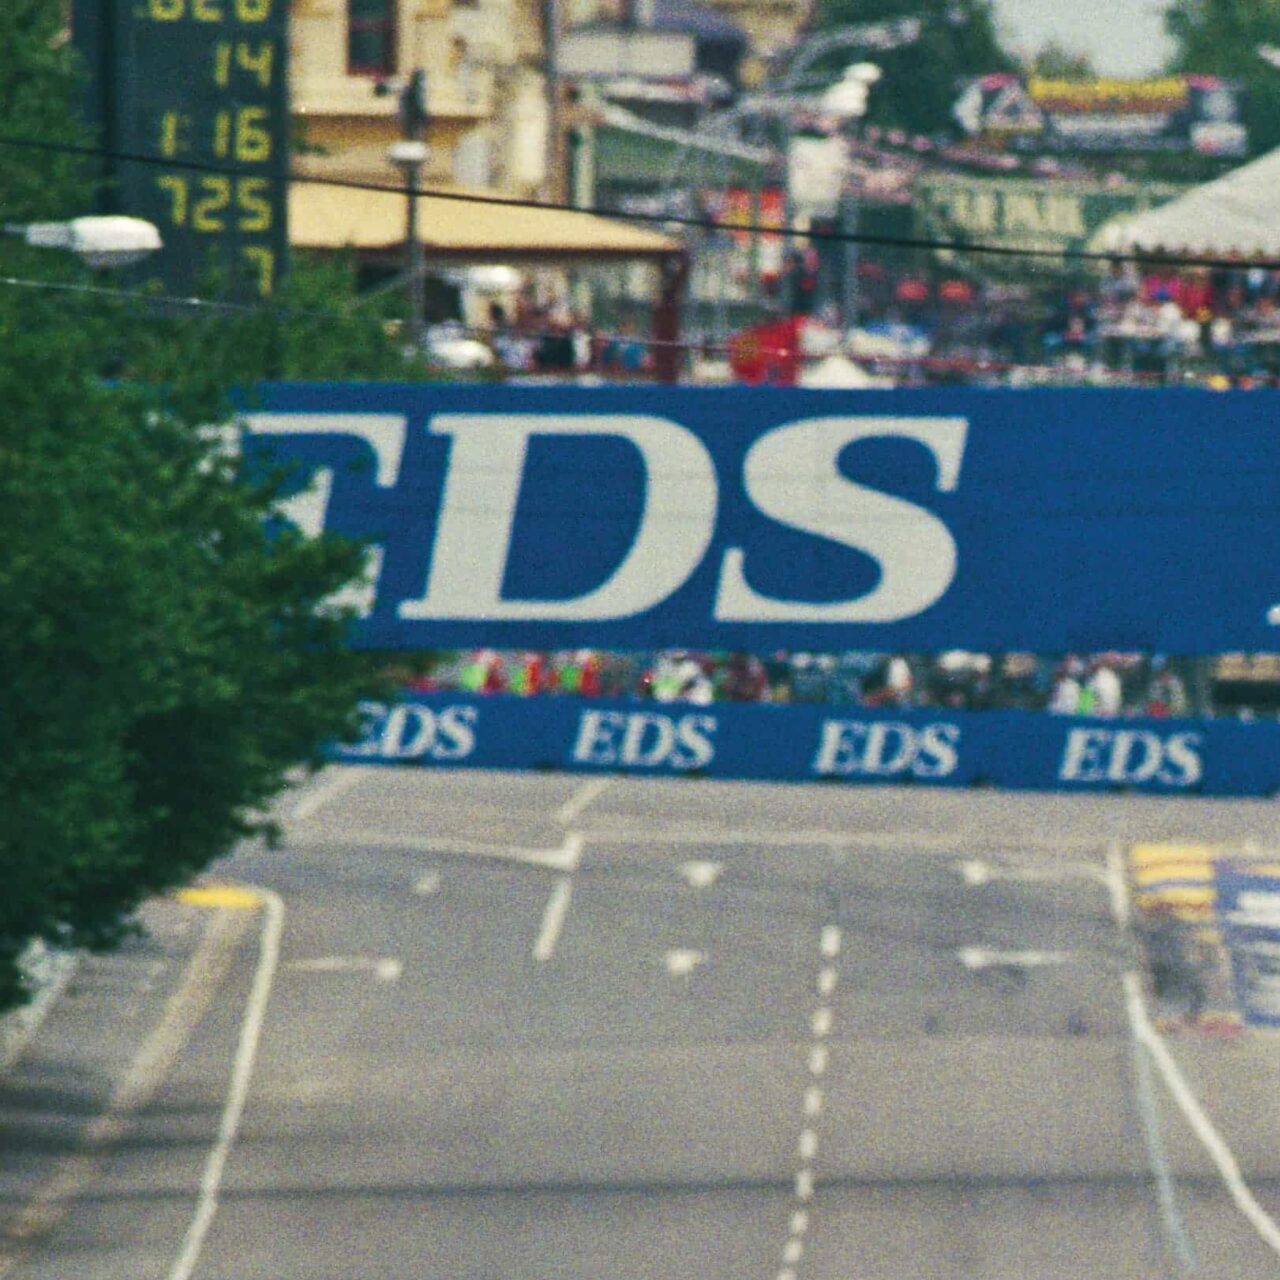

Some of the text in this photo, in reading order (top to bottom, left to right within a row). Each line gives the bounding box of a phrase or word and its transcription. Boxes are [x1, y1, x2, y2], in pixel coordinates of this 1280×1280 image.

[214, 43, 273, 88] 14
[159, 175, 272, 232] 725
[572, 709, 717, 768] EDS
[814, 719, 960, 777] EDS
[1059, 727, 1202, 785] EDS
